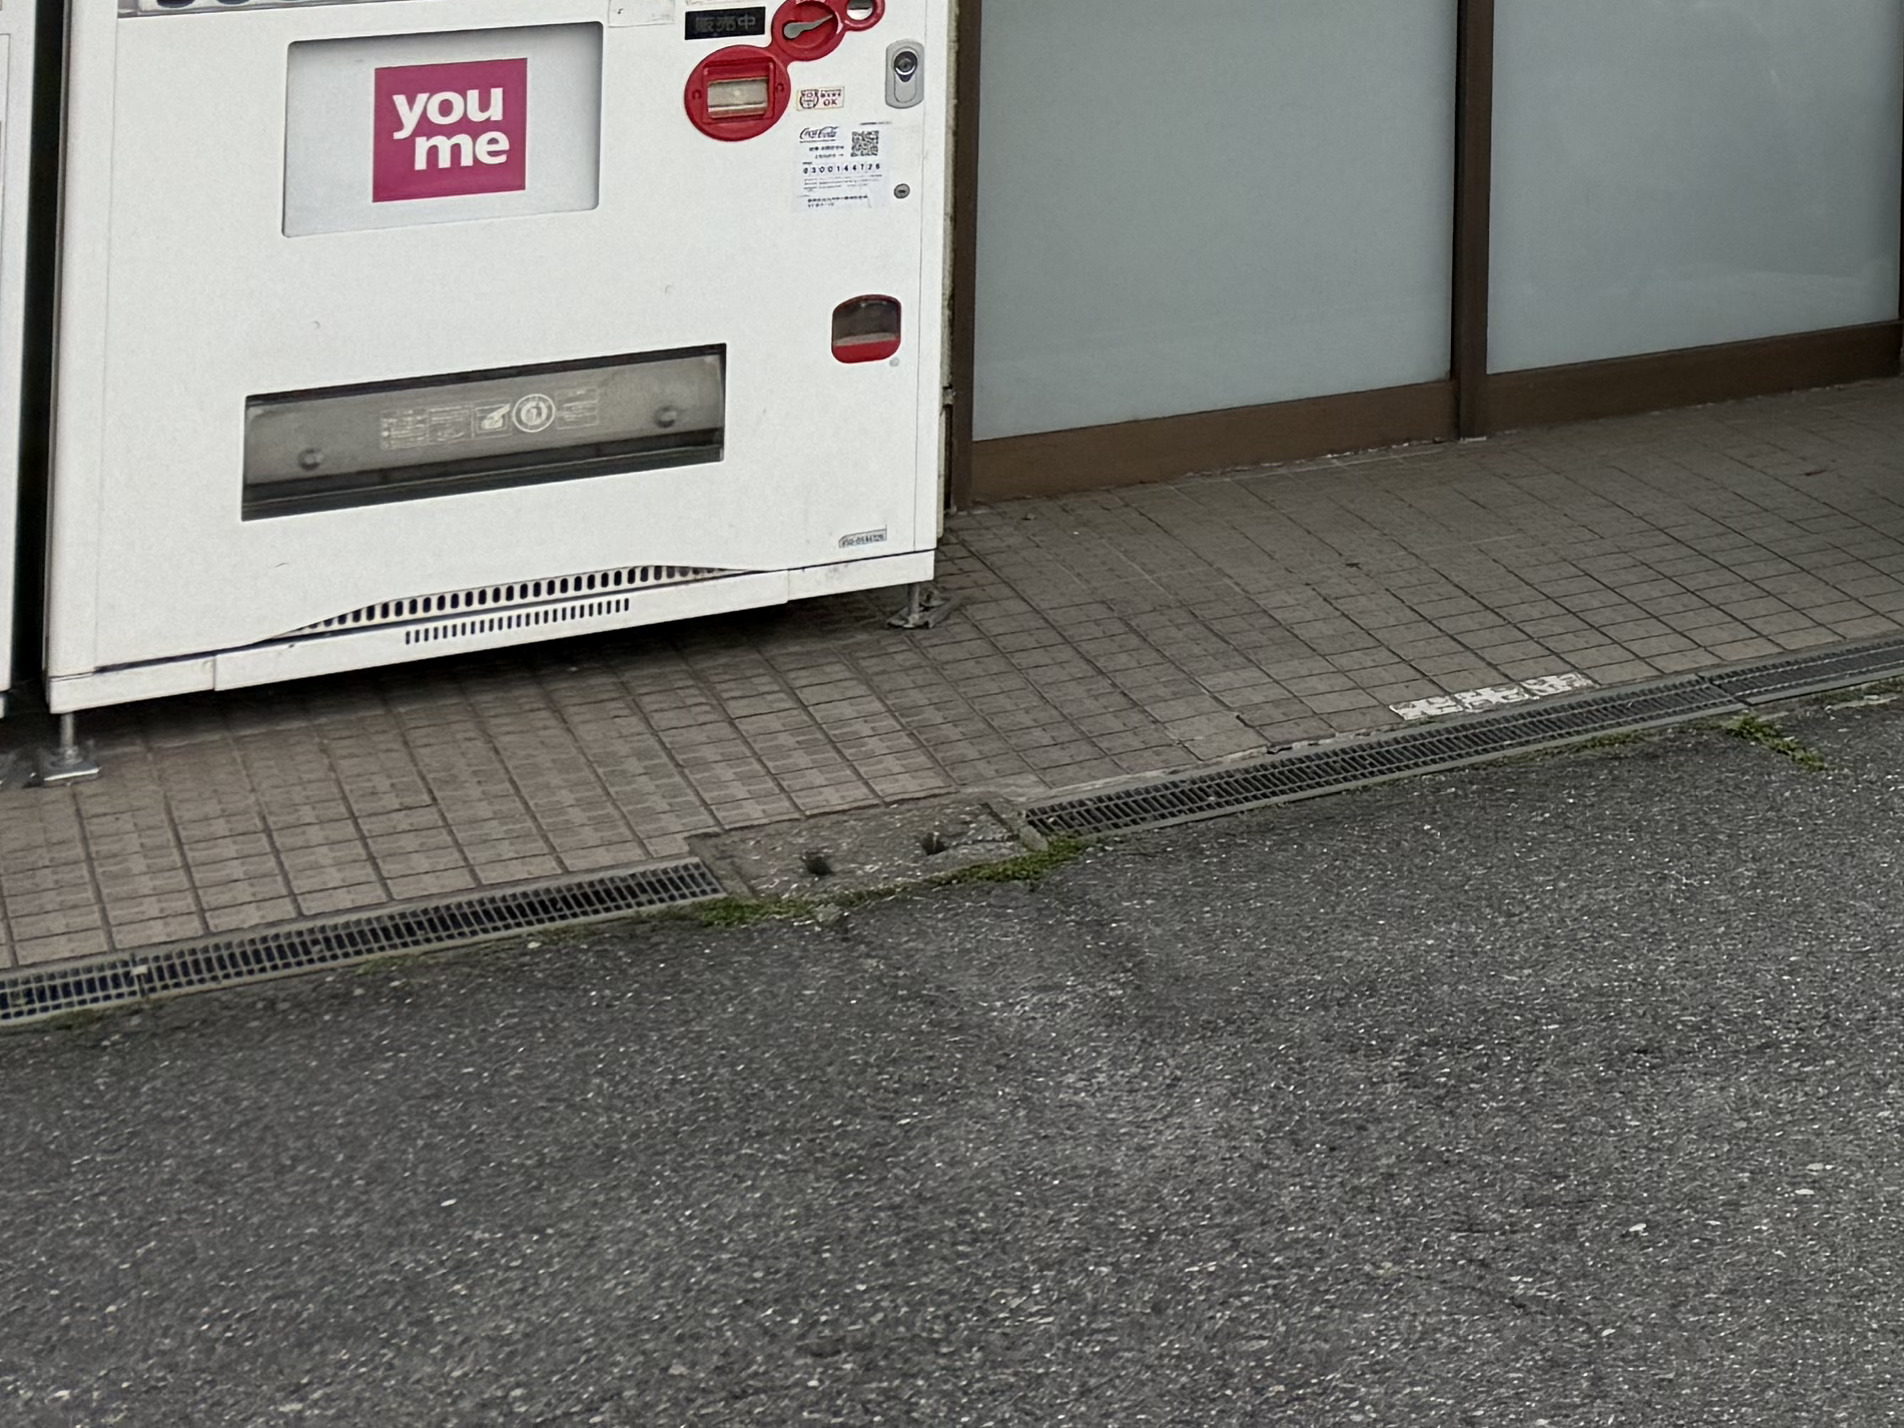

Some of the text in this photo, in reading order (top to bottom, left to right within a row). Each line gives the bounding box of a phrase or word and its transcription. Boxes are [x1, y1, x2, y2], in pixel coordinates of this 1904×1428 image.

[695, 12, 757, 34] 販売中
[392, 85, 505, 140] you
[823, 98, 838, 107] OK
[412, 128, 511, 172] me
